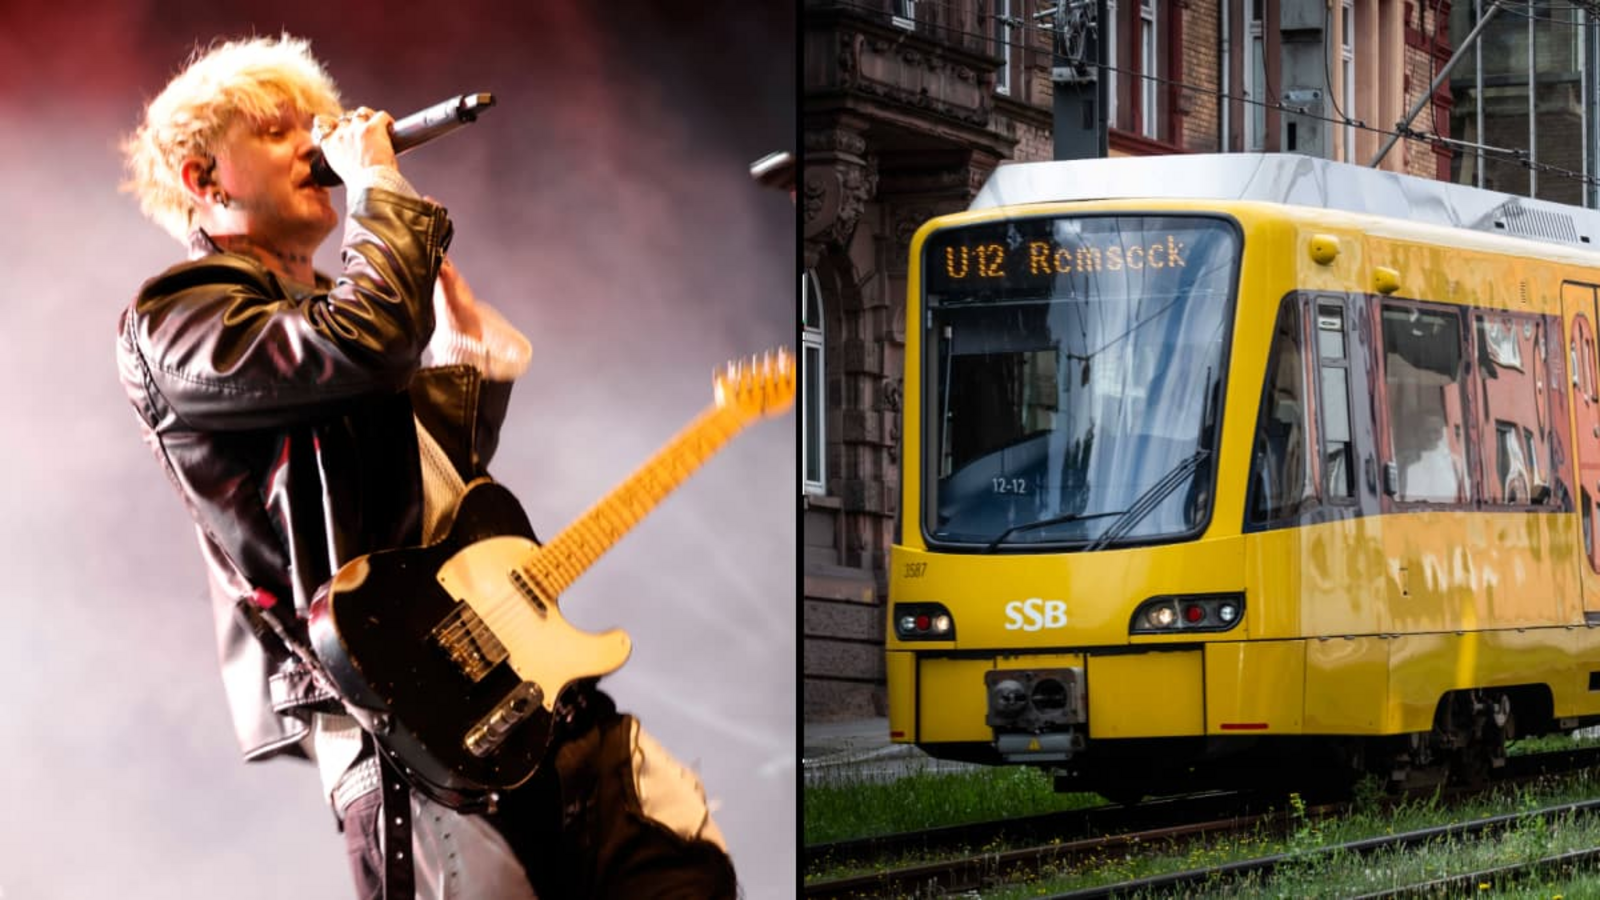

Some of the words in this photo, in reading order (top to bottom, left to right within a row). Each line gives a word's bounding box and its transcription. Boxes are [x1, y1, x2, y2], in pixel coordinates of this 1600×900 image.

[946, 244, 1005, 278] U12
[992, 478, 1026, 493] 12-12
[1004, 598, 1068, 631] SSB
